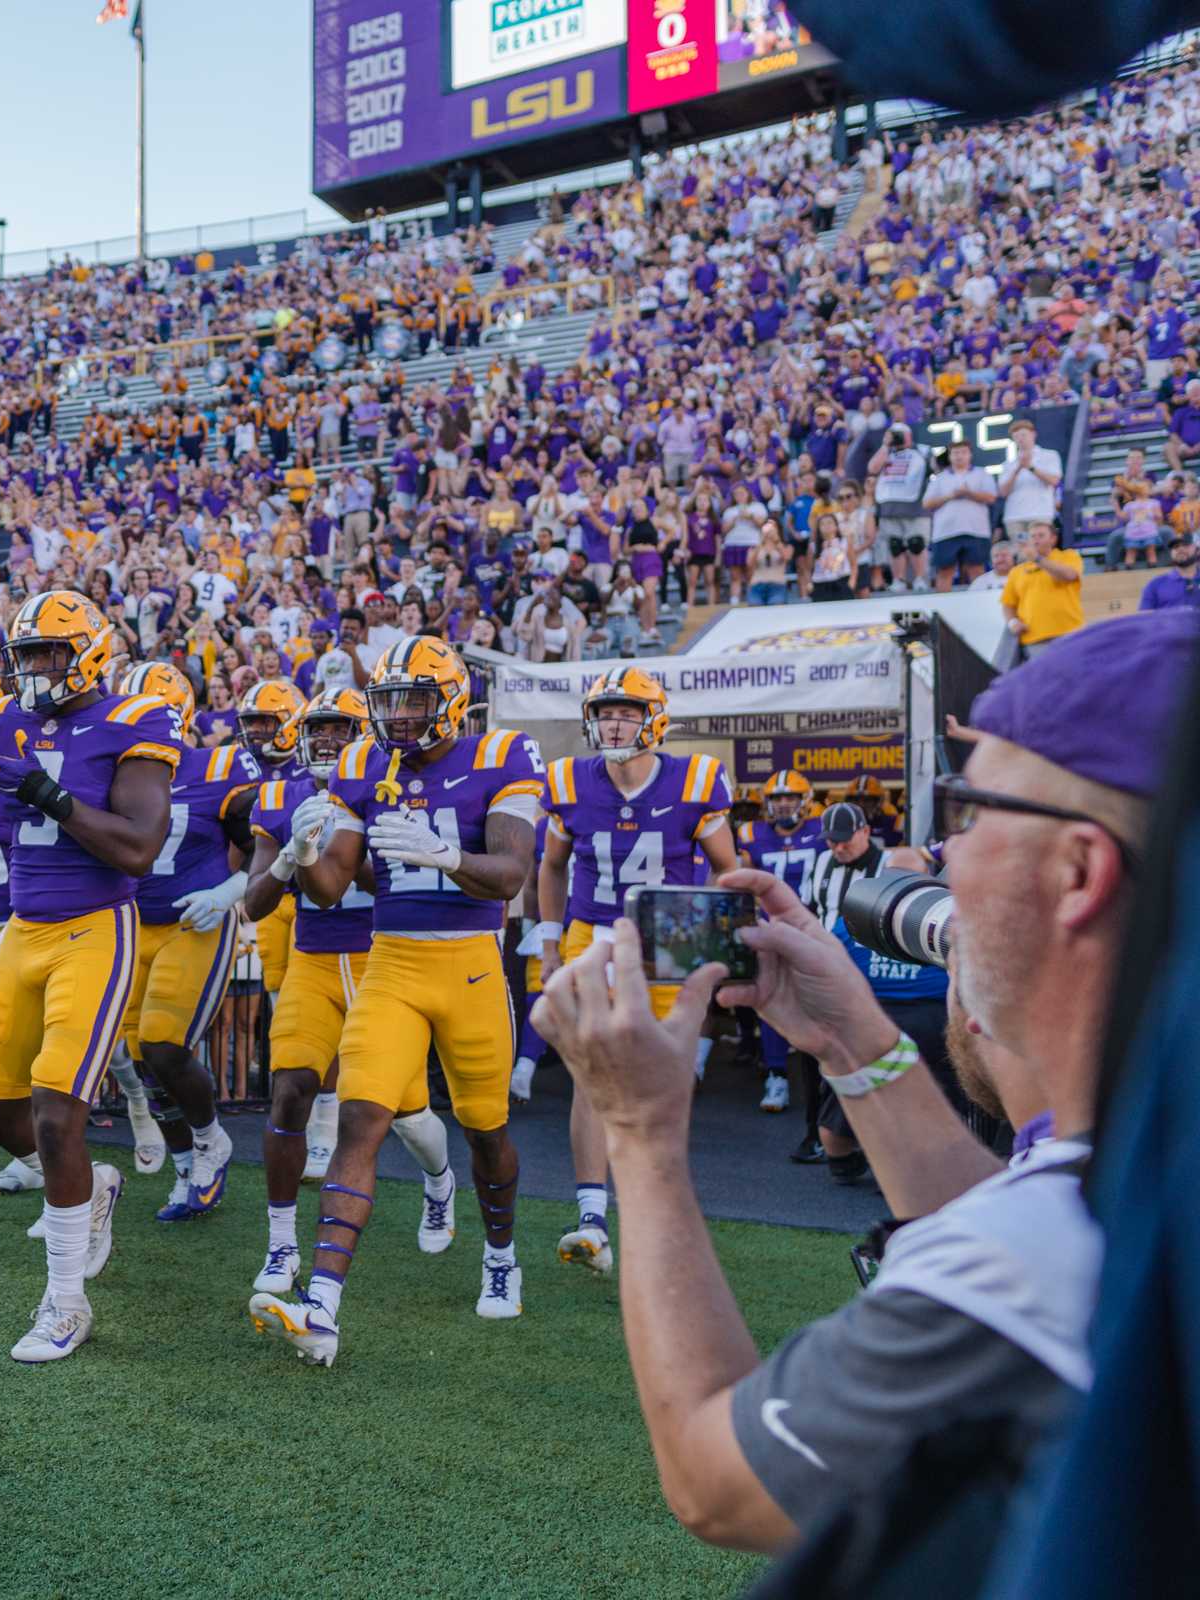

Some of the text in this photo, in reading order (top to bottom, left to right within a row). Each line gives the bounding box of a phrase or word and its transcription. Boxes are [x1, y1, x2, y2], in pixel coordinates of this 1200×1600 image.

[347, 11, 402, 54] 1958
[496, 14, 580, 53] HEALTH
[658, 13, 687, 48] 0
[346, 46, 406, 91] 2003
[346, 83, 406, 126] 2007
[471, 69, 595, 140] LSU
[348, 119, 403, 160] 2019
[504, 678, 533, 693] 1958
[539, 678, 570, 693] 2003
[680, 664, 796, 691] CHAMPIONS
[809, 664, 848, 682] 2007
[855, 660, 890, 678] 2019
[708, 713, 788, 733] NATIONAL
[796, 709, 900, 731] CHAMPIONS
[25, 740, 55, 750] LSU
[793, 746, 905, 772] CHAMPIONS
[591, 831, 666, 905] 14
[761, 847, 817, 906] 77
[868, 962, 922, 981] STAFF
